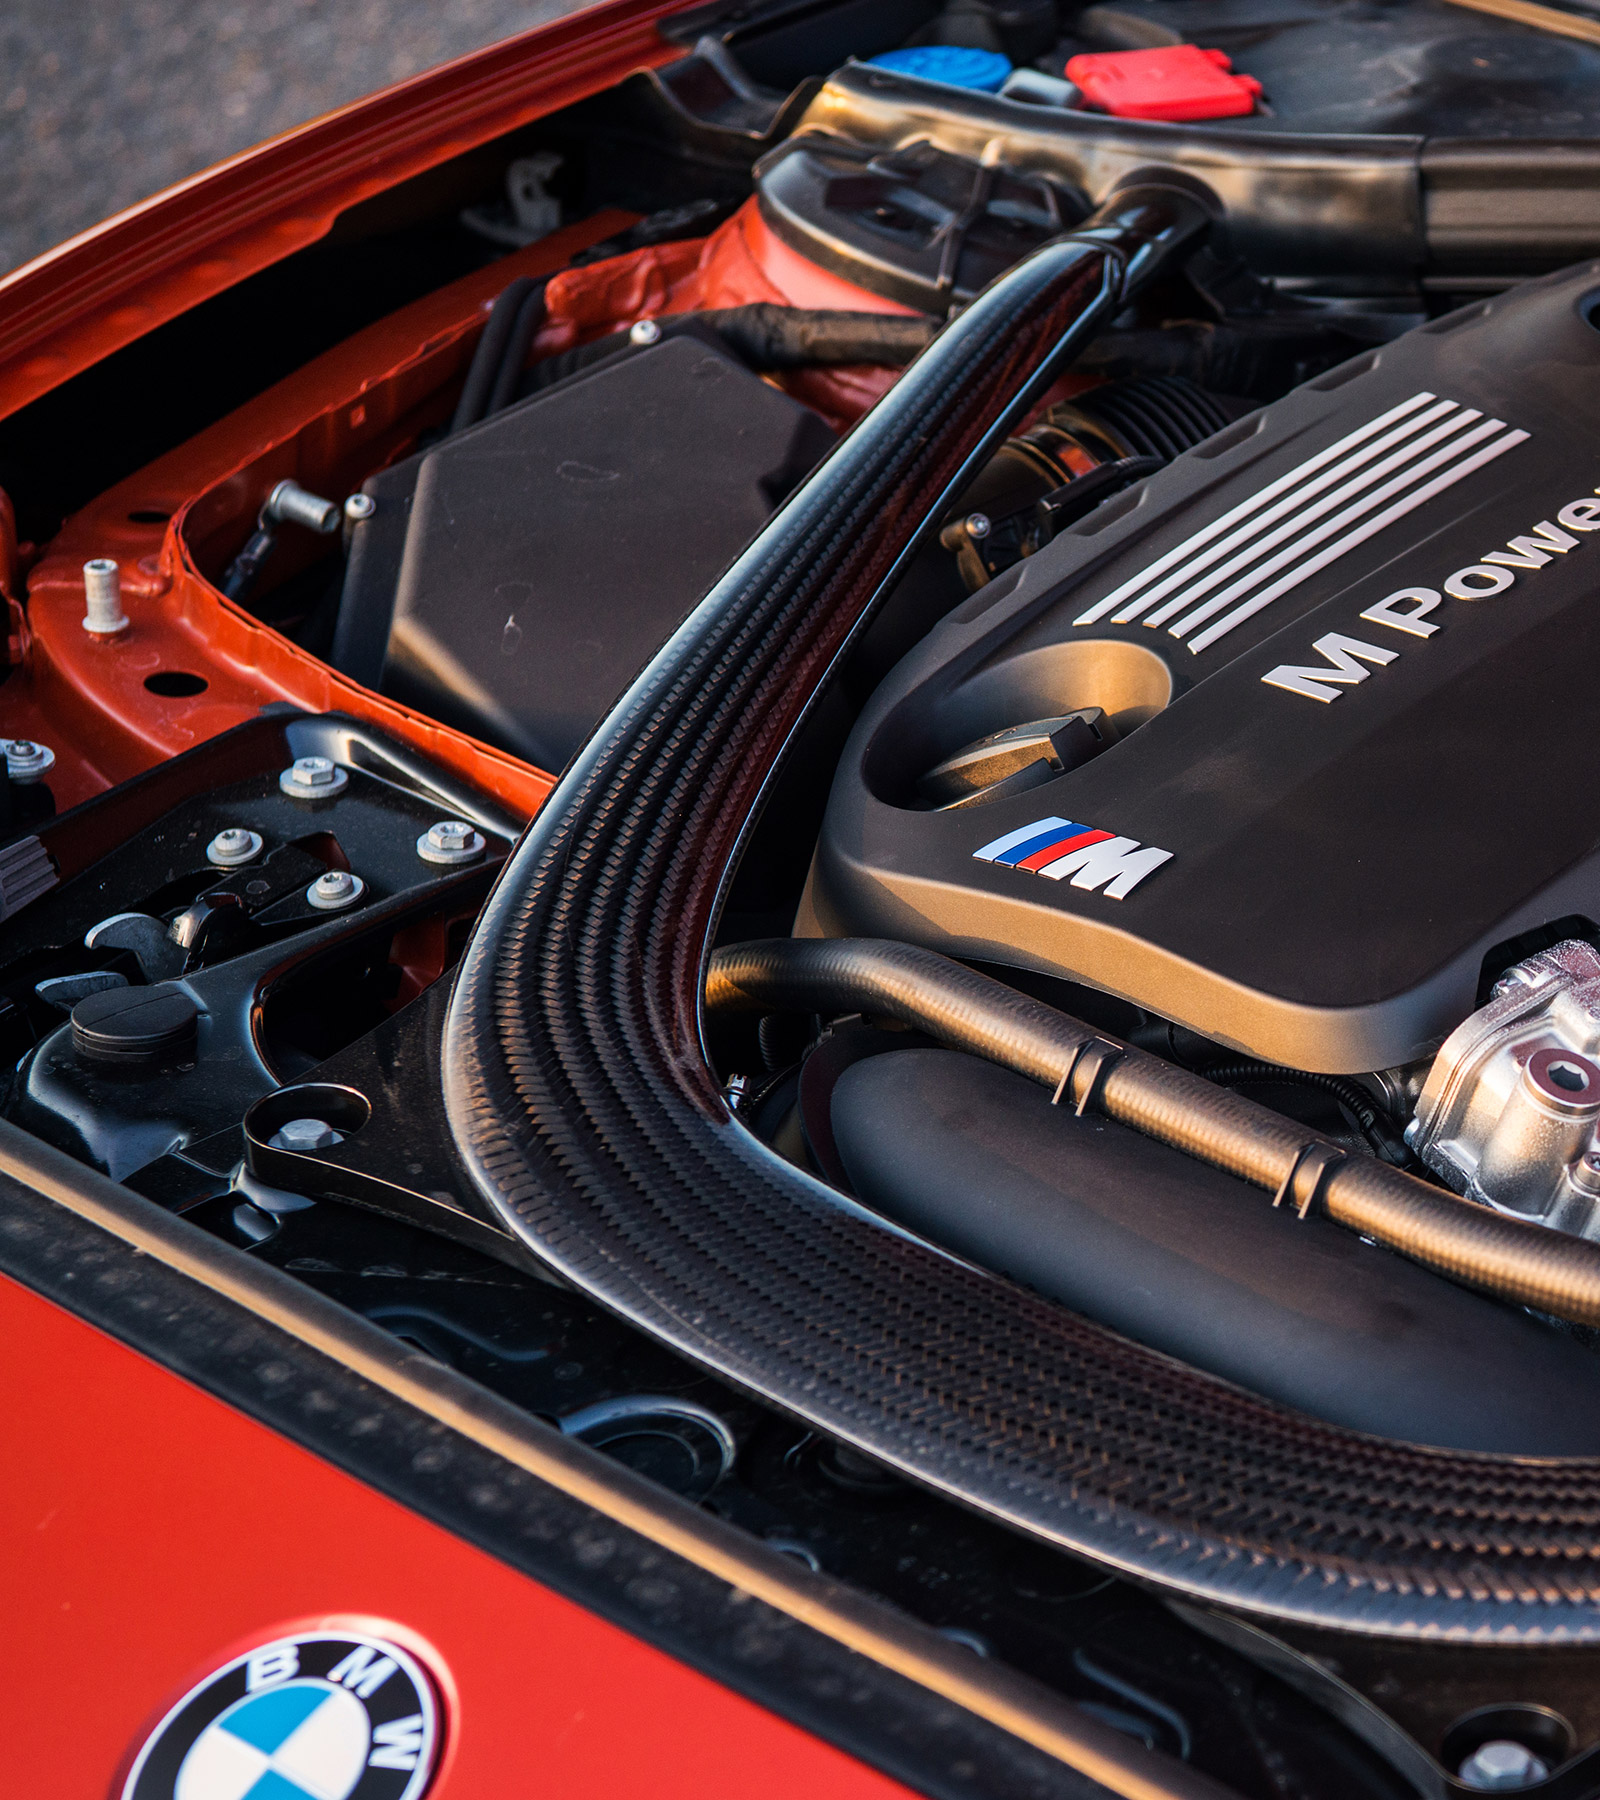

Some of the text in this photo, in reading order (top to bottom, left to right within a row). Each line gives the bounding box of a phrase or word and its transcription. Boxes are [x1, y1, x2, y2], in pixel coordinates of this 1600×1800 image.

[1261, 631, 1400, 704] M
[1036, 834, 1175, 901] M
[246, 1644, 425, 1771] BMW
